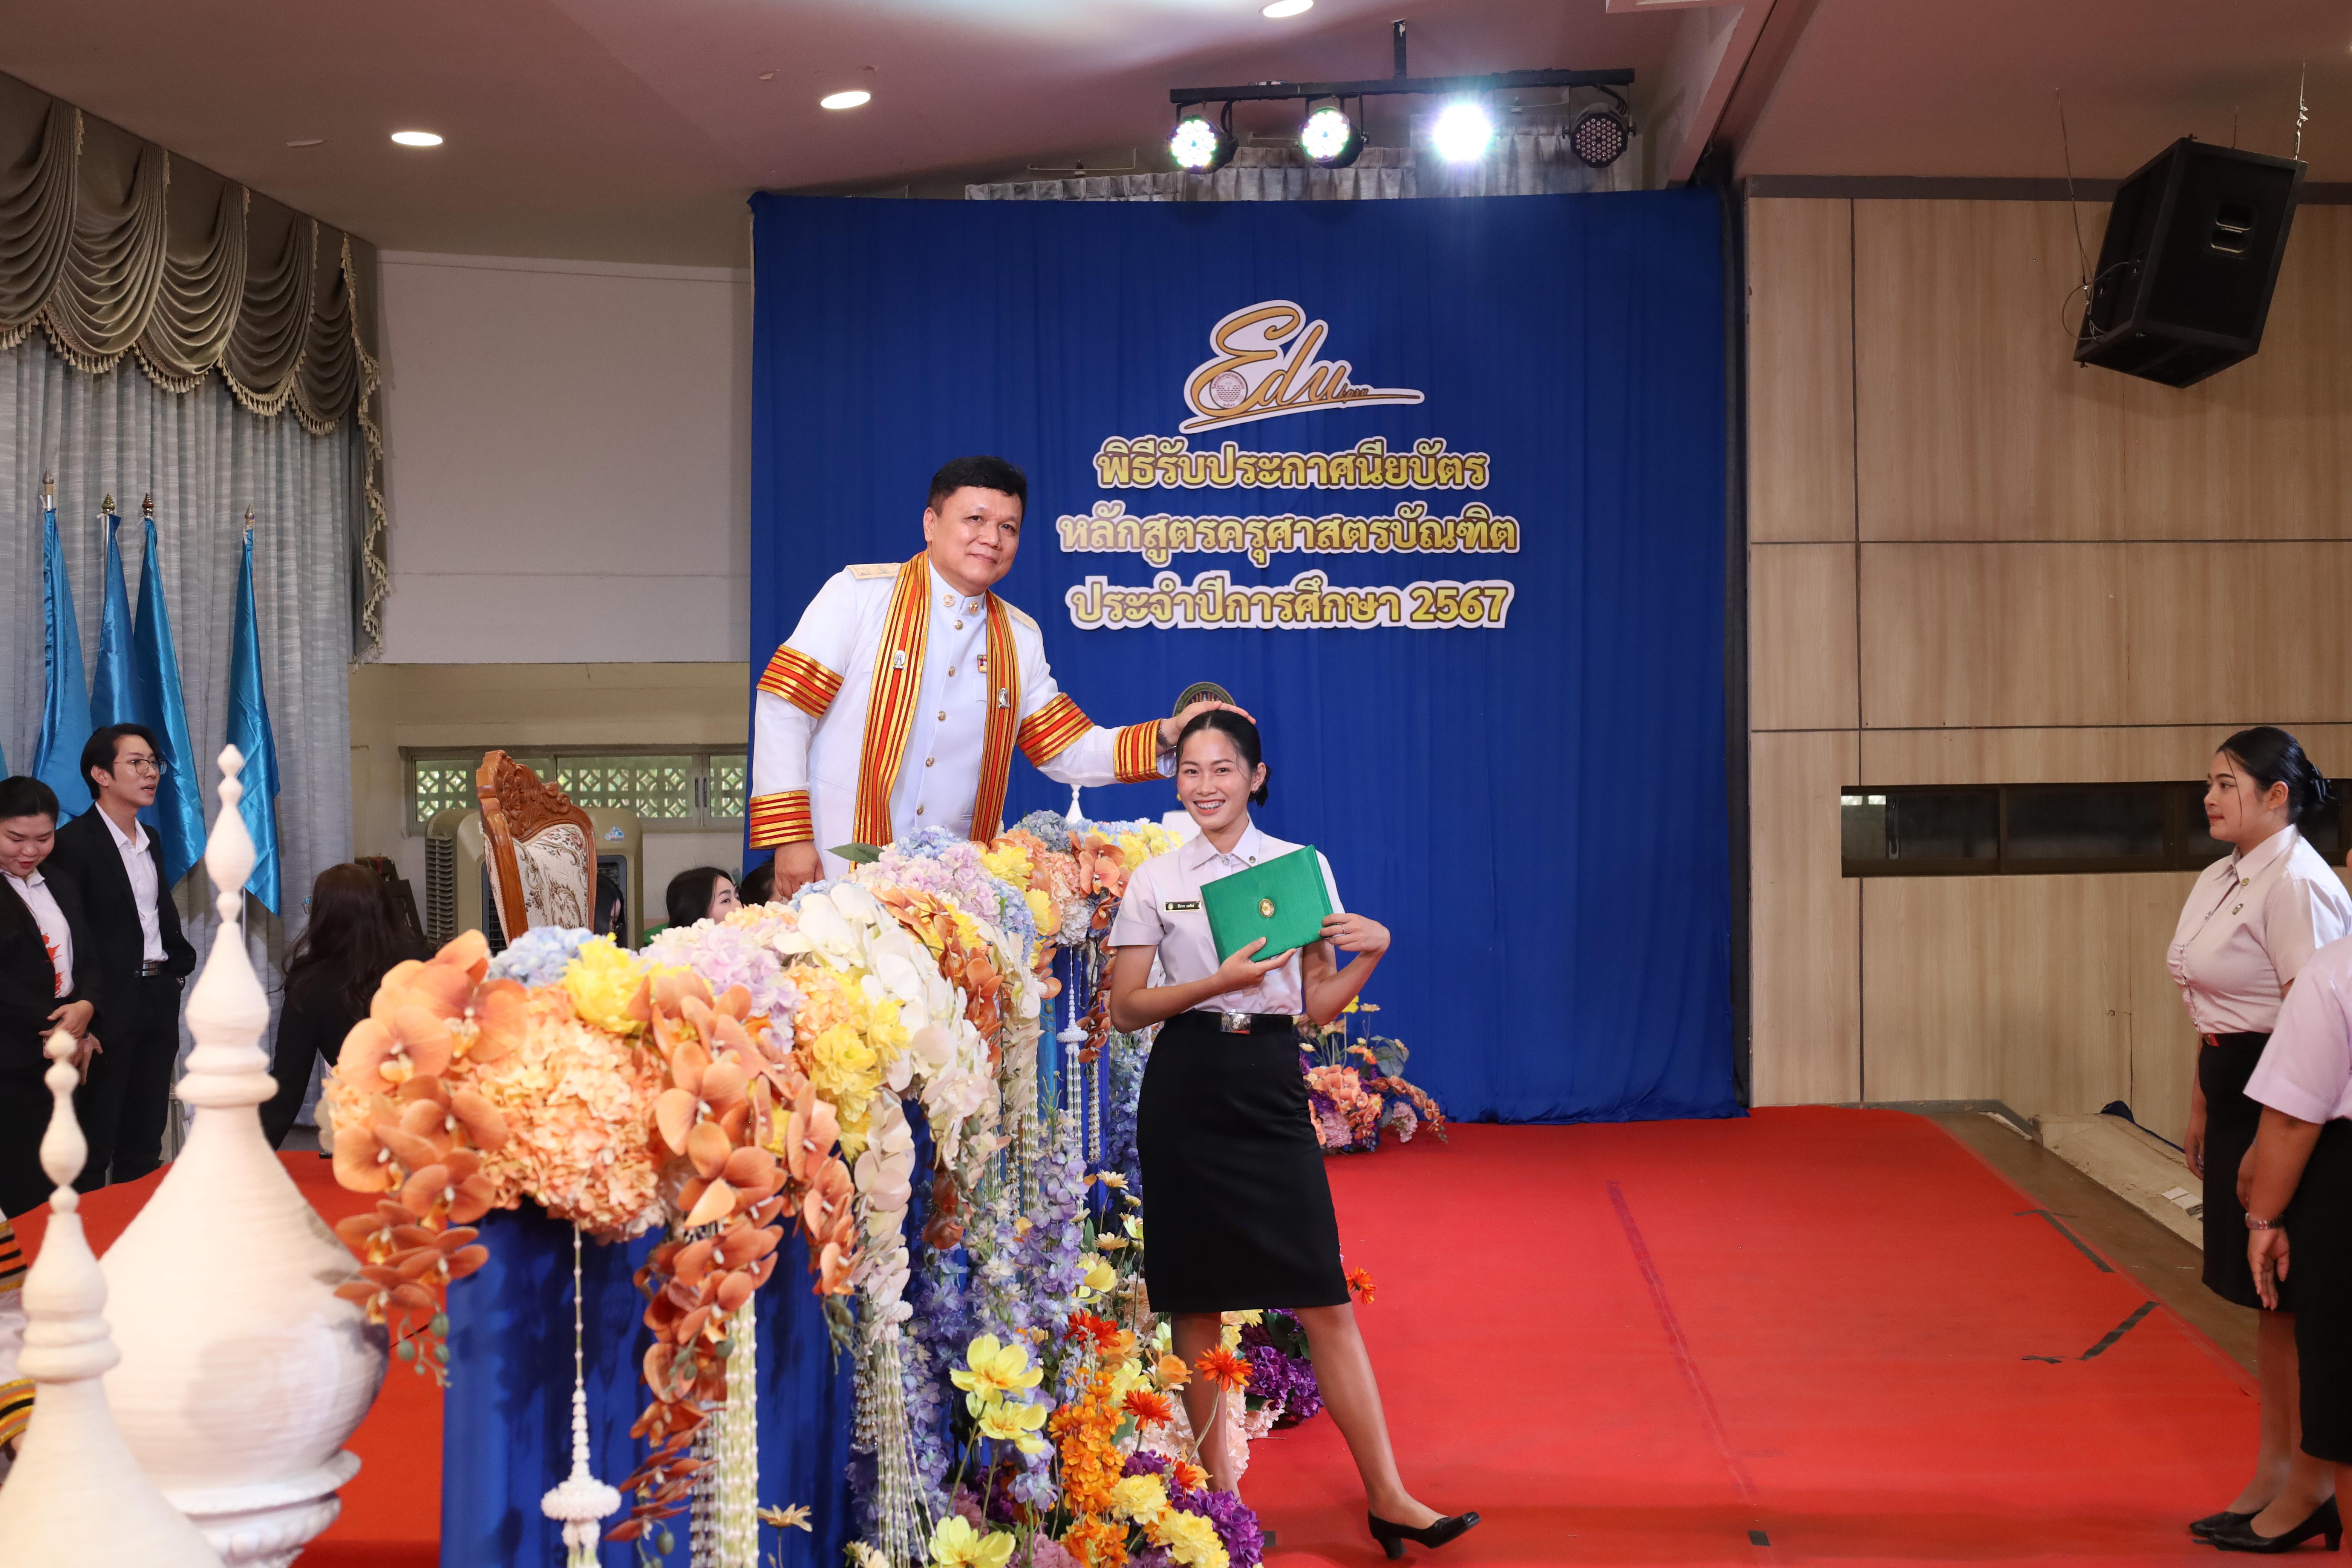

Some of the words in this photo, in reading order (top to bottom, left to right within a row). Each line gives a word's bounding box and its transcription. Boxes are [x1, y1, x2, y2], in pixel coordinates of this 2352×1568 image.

[1191, 306, 1347, 418] Edu
[1096, 438, 1487, 486] พิธีรับประกาศนียบัตร
[1058, 504, 1519, 565] หลักสูตรครุศาสตรบัณฑิต
[1071, 576, 1401, 623] ประจำปีการศึกษา
[1409, 586, 1508, 623] 2567
